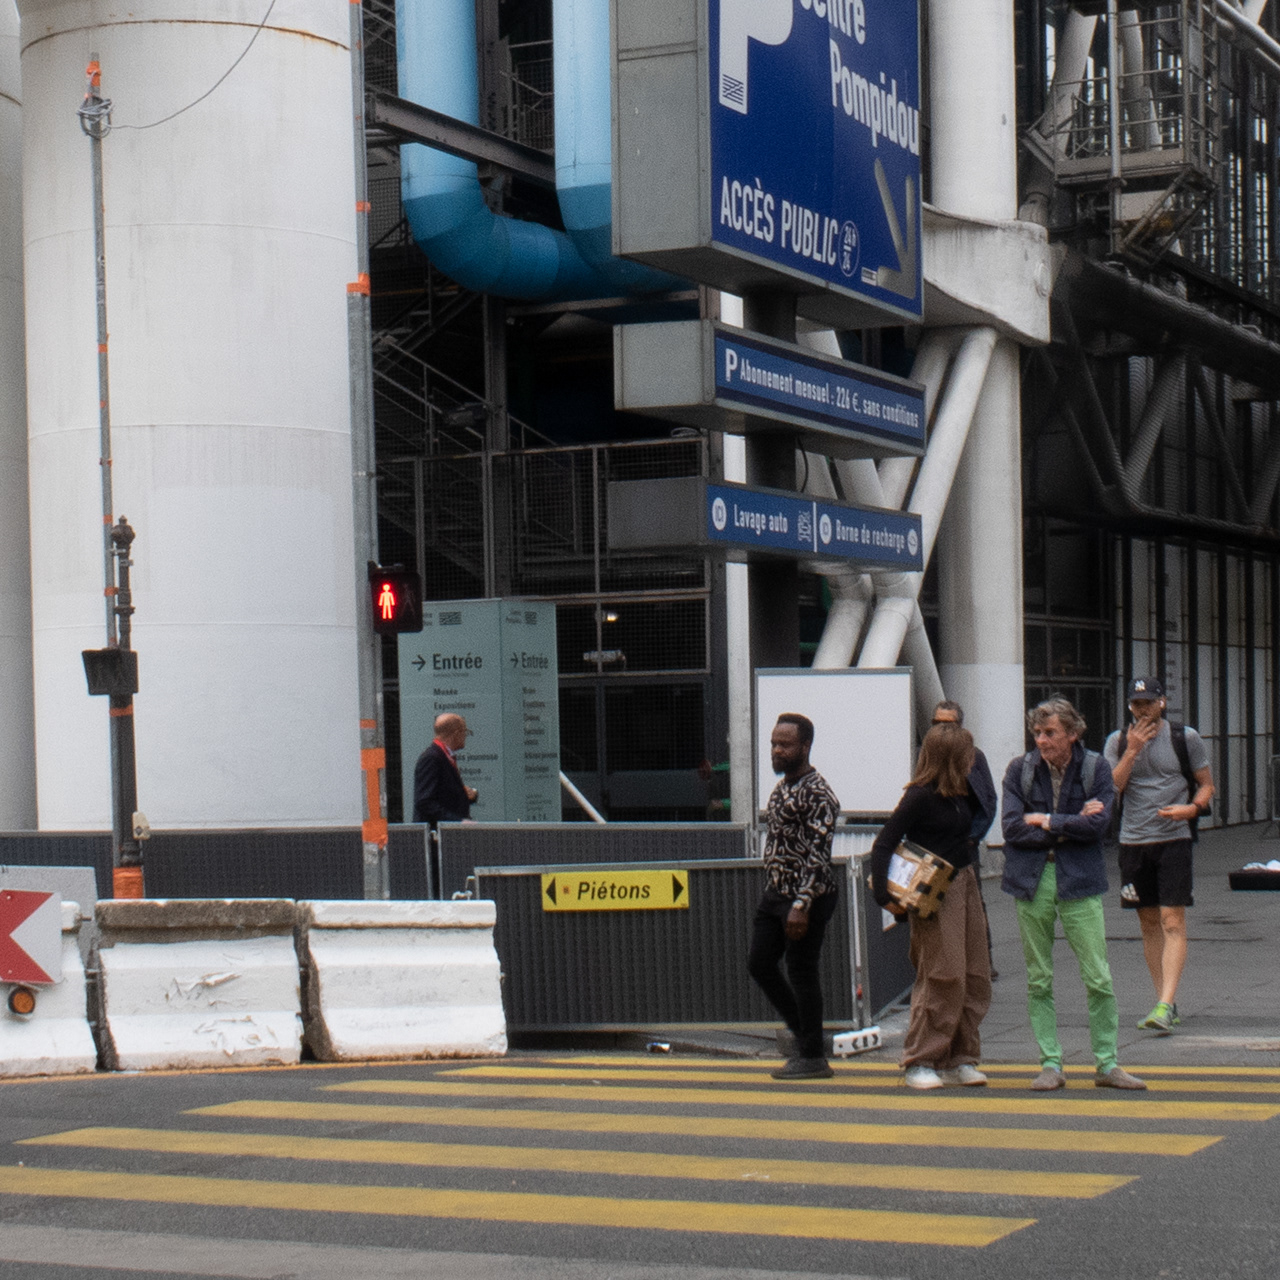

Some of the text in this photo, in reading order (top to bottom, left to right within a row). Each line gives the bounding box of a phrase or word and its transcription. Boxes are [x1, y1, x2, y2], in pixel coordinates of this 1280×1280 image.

[829, 37, 920, 157] Pompidou
[720, 174, 839, 267] ACCÈS PUBLIC
[725, 347, 738, 382] P
[740, 357, 793, 394] Abonnement
[795, 379, 830, 404] mensuel
[836, 385, 851, 411] 226
[862, 398, 881, 419] sans
[882, 402, 919, 429] conditions
[734, 503, 767, 536] Lavage
[768, 511, 789, 534] auto
[836, 518, 859, 544] Borne
[861, 523, 871, 545] de
[872, 526, 905, 555] recharge
[432, 652, 483, 671] Entrée
[521, 652, 549, 670] Entrée
[578, 880, 651, 901] Piétons
